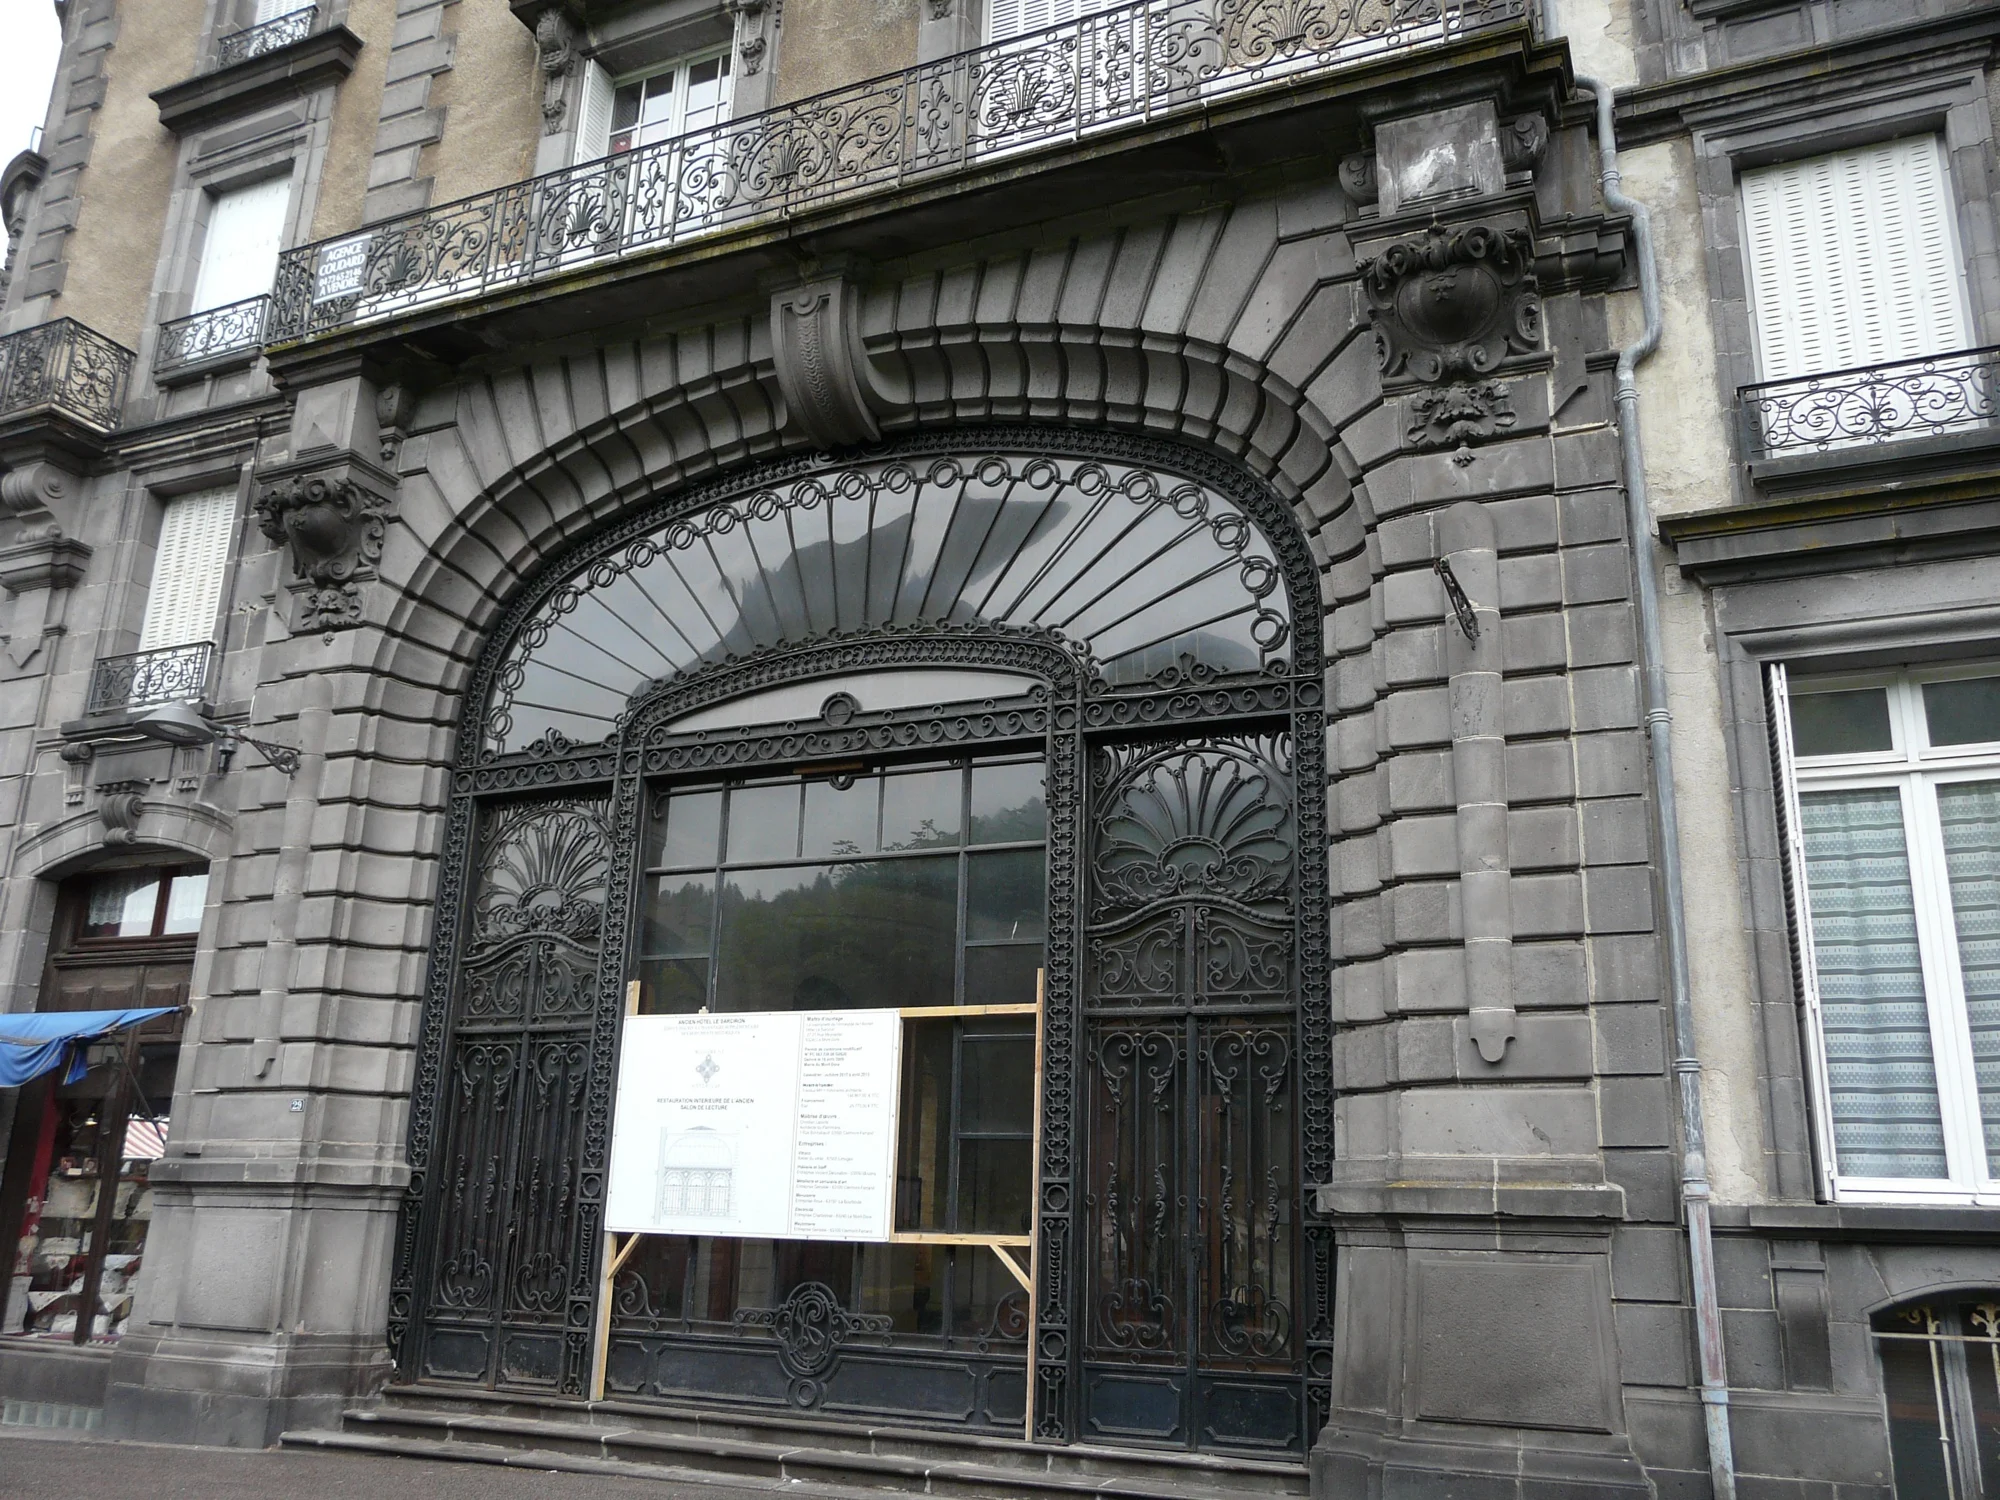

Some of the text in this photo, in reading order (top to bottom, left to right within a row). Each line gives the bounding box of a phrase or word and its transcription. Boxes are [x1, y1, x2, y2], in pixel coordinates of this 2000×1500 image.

[326, 242, 363, 262] AGENCE
[319, 254, 365, 276] COUDARD
[319, 276, 359, 296] A VENDRE
[292, 1101, 302, 1110] 29
